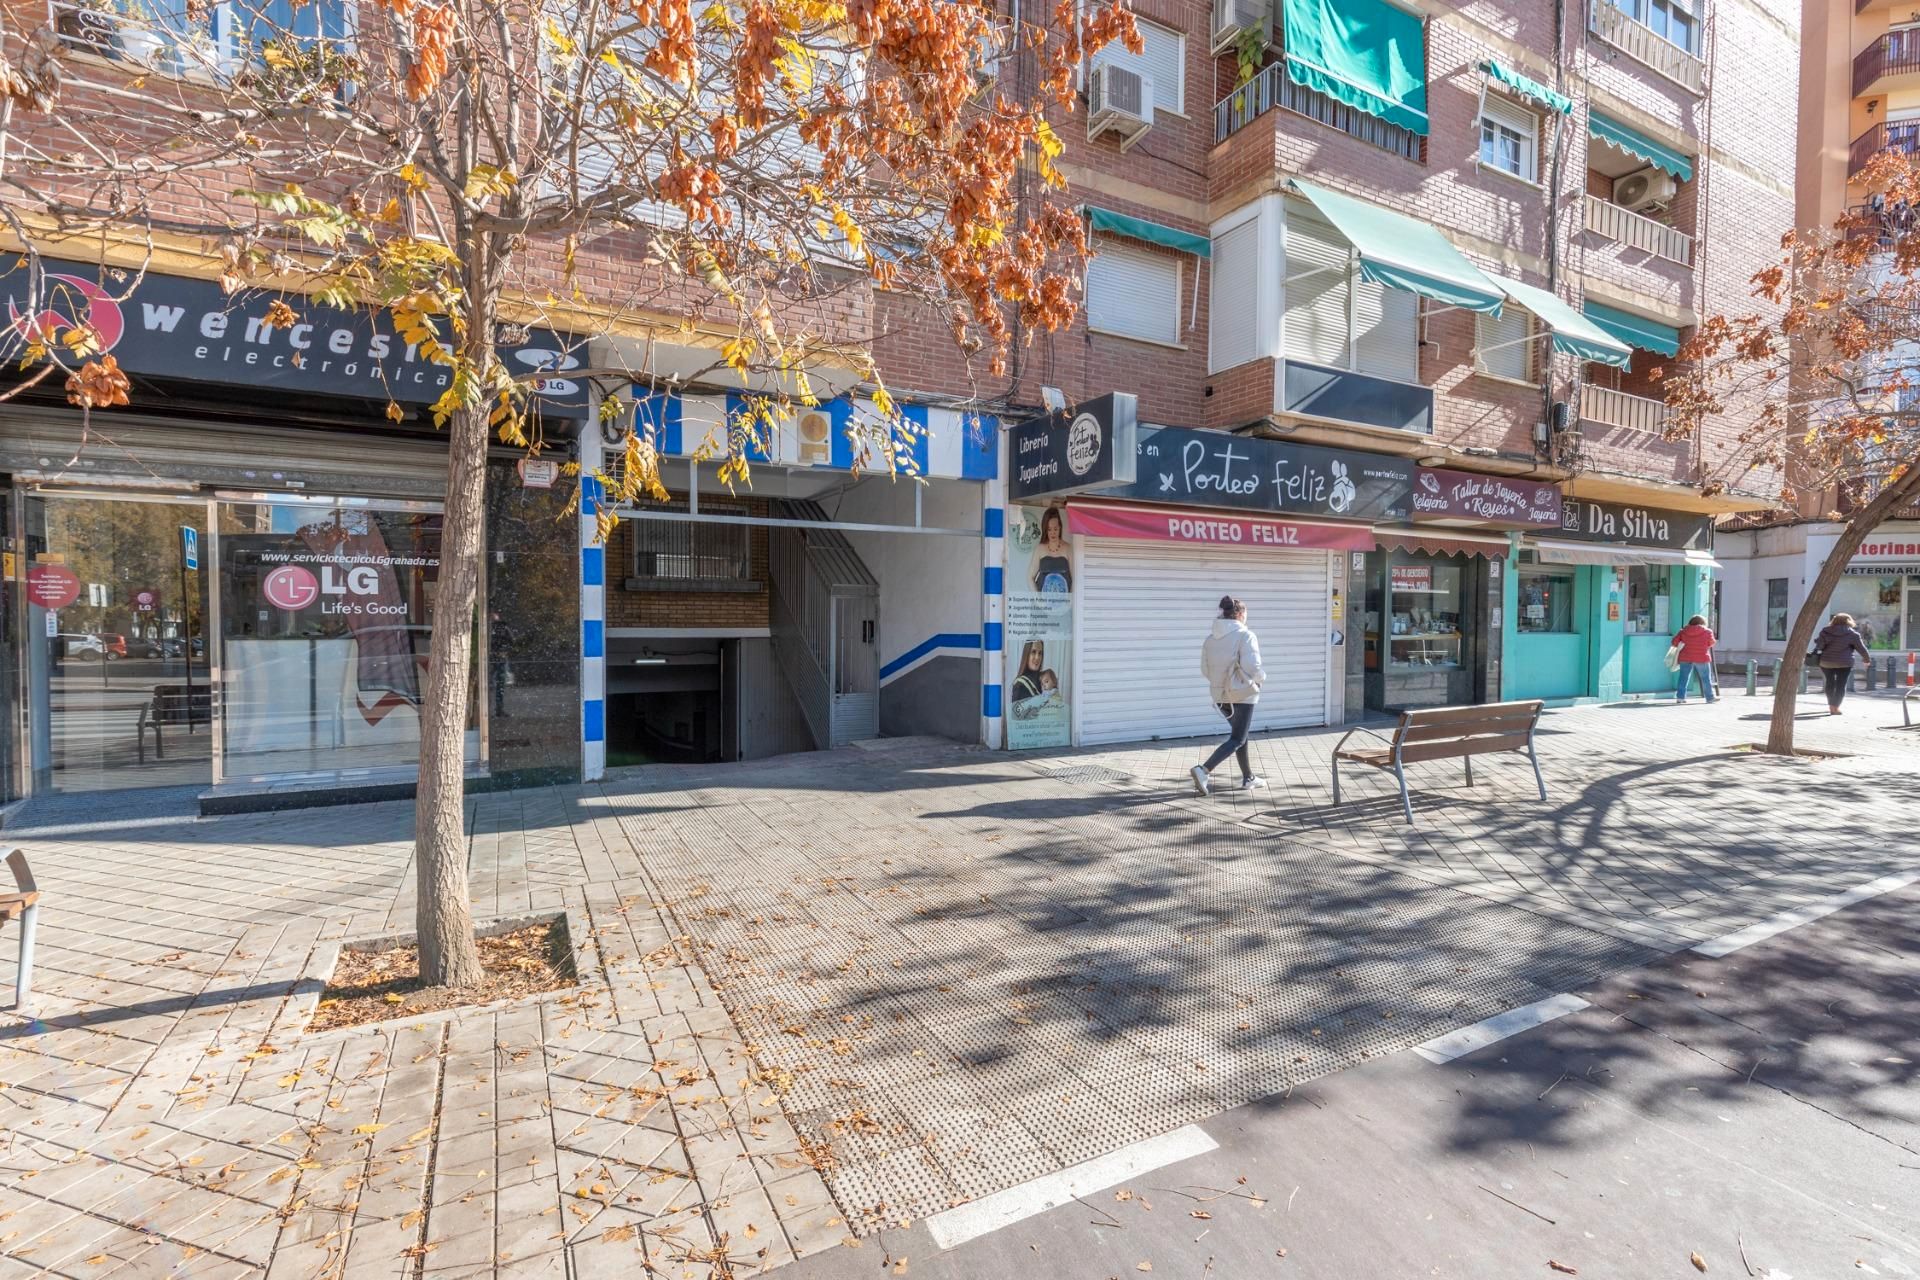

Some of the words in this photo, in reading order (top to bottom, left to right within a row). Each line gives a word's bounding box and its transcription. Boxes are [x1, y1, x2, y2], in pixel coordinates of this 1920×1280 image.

[194, 345, 448, 386] electrónica
[549, 381, 565, 391] LG
[1146, 445, 1159, 457] en
[1019, 459, 1058, 483] Juguetería
[1183, 440, 1260, 494] Porteo
[1412, 493, 1449, 511] Relojería
[1452, 479, 1479, 501] Taller
[1482, 478, 1494, 495] de
[1494, 482, 1528, 509] Joyería
[1471, 497, 1510, 518] Reyes
[1528, 508, 1557, 523] Joyería
[1168, 519, 1242, 542] PORTEO
[1252, 524, 1299, 545] FELIZ
[1588, 503, 1616, 536] Da
[1622, 508, 1670, 541] Silva
[321, 566, 379, 595] LG
[1843, 567, 1920, 575] VETERINARI
[321, 602, 362, 615] Life's
[366, 602, 408, 615] Good
